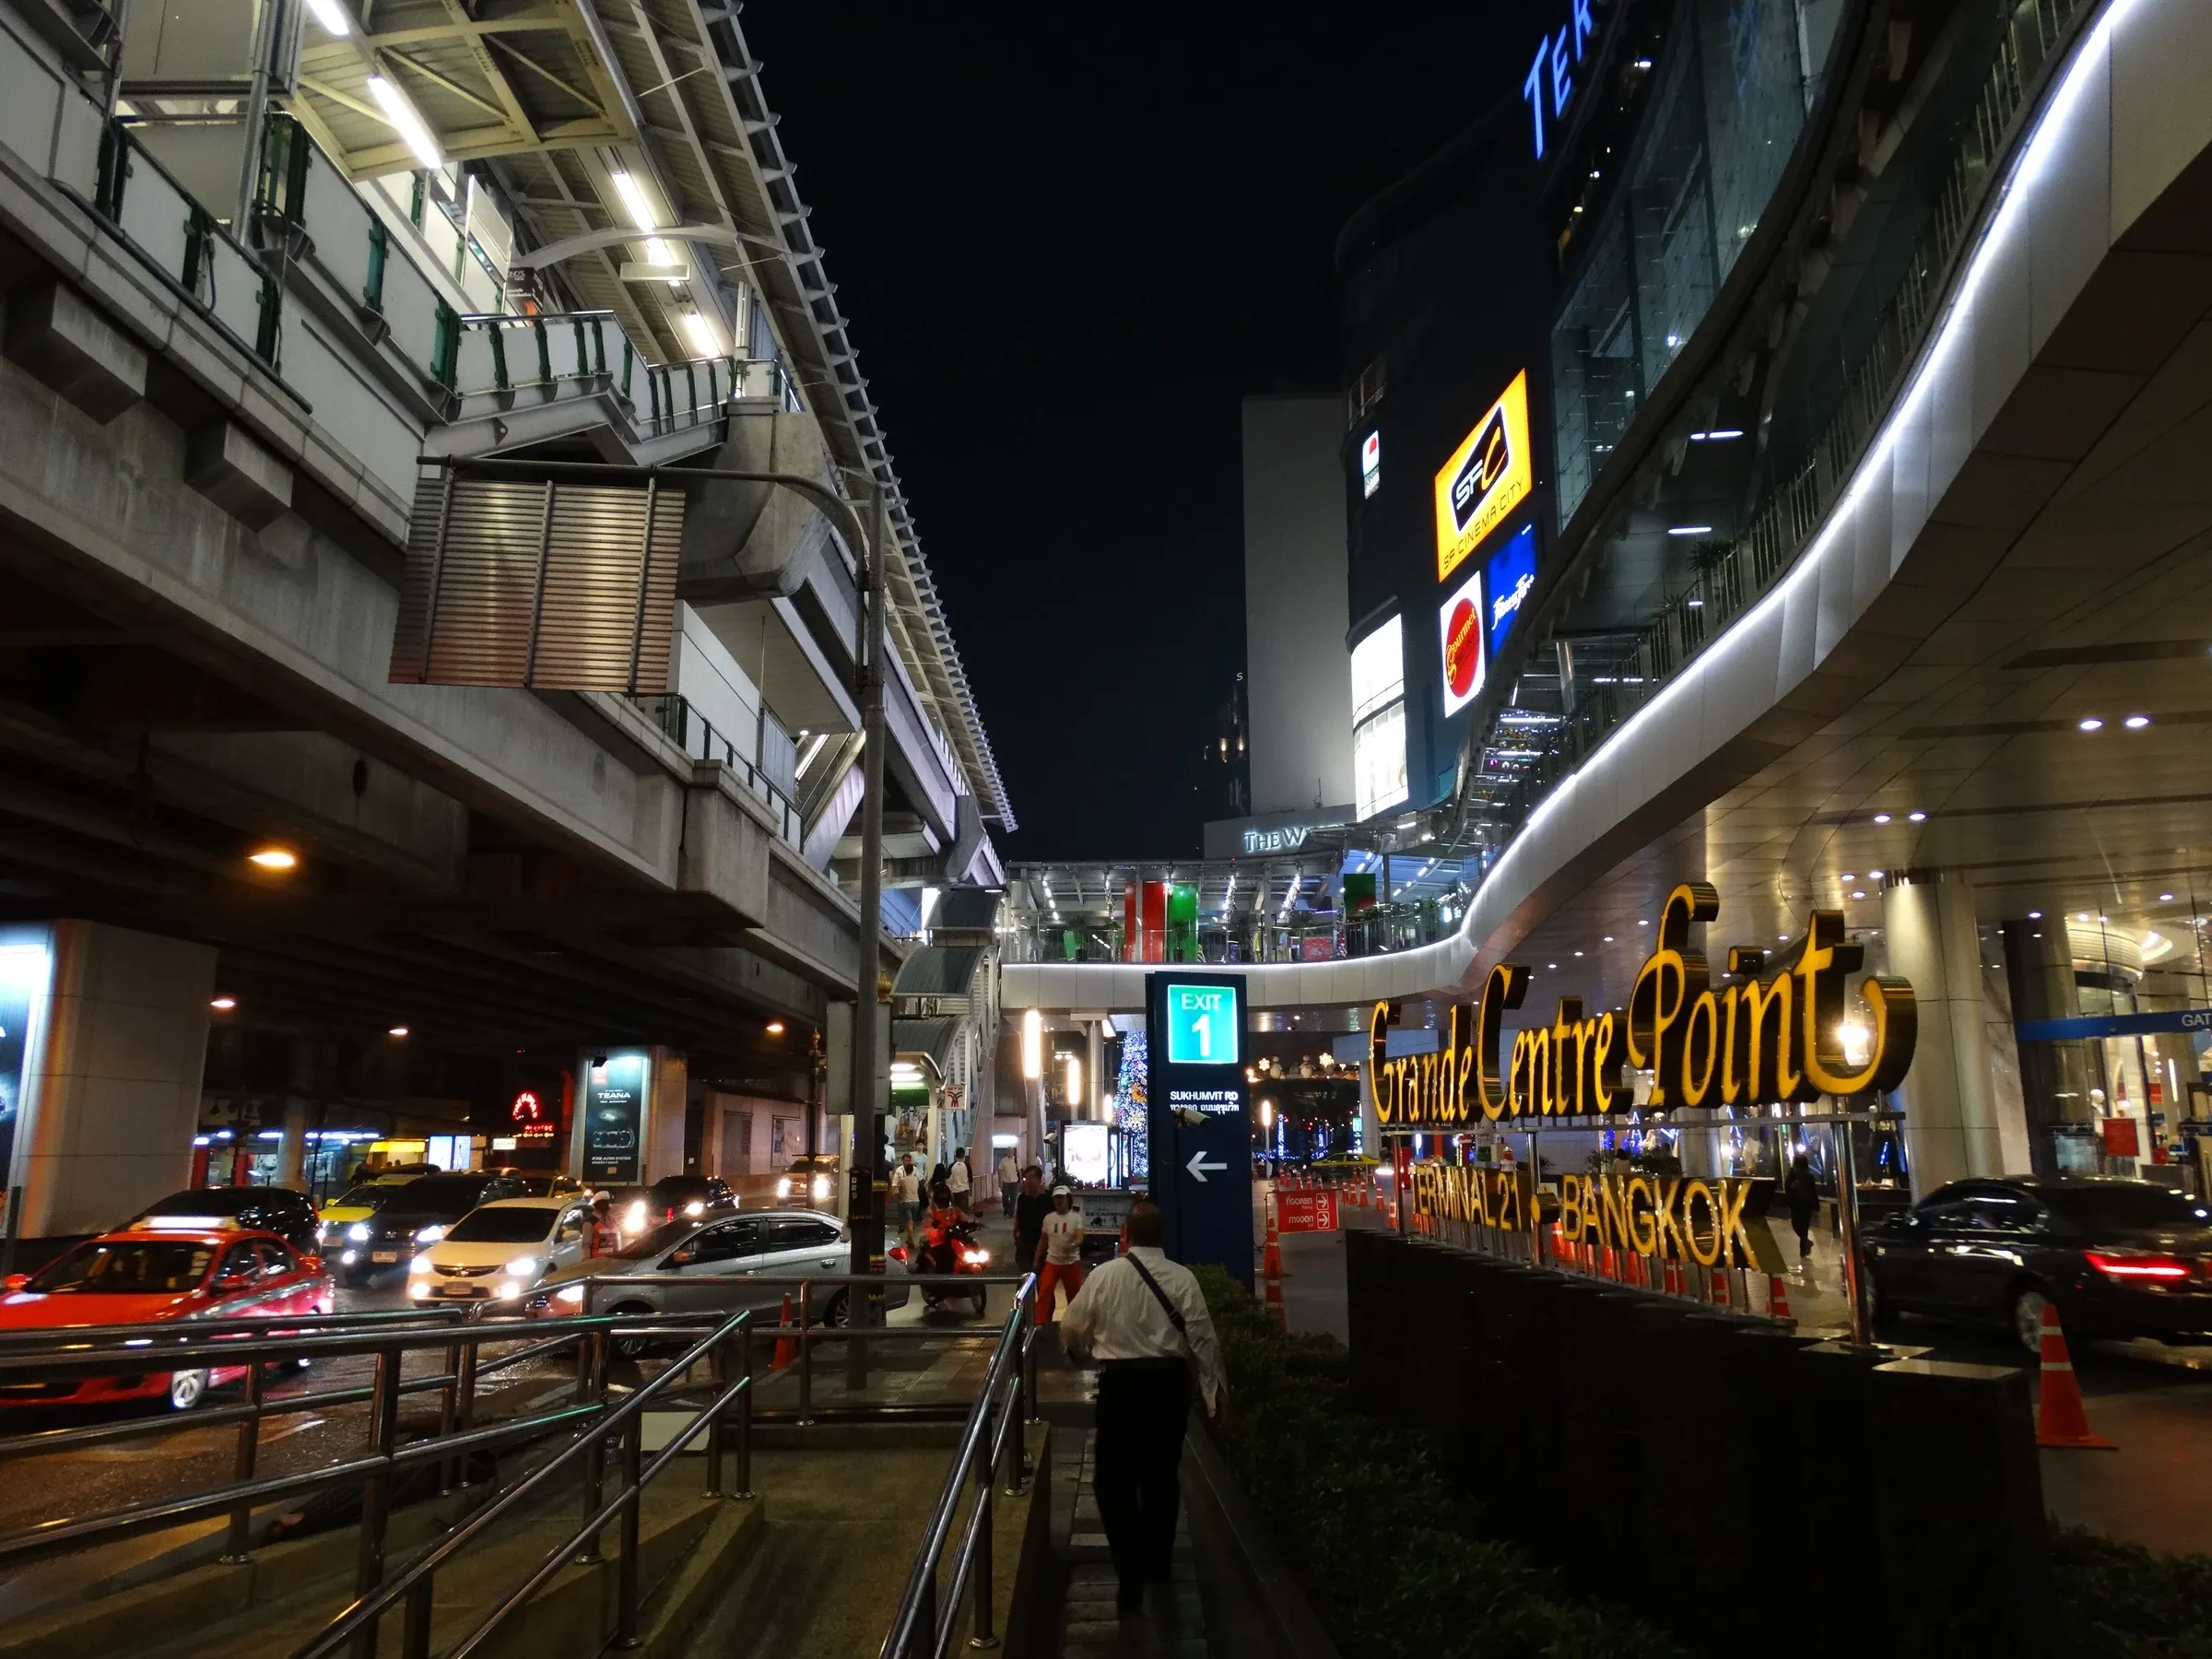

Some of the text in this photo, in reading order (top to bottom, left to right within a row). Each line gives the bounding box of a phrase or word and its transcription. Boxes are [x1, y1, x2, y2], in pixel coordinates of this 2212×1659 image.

[1455, 426, 1508, 511] SFC
[1443, 476, 1524, 570] SF CINEMA CITY
[1243, 827, 1306, 851] THE W
[1181, 993, 1222, 1011] EXIT
[1370, 883, 1888, 1123] Grande Centre Point
[1191, 1014, 1211, 1057] 1
[1170, 1090, 1239, 1101] SUKHUMVIT RD
[1288, 1215, 1313, 1223] ทางออก
[1411, 1165, 1759, 1271] TERMINAL 21 BANGKOK
